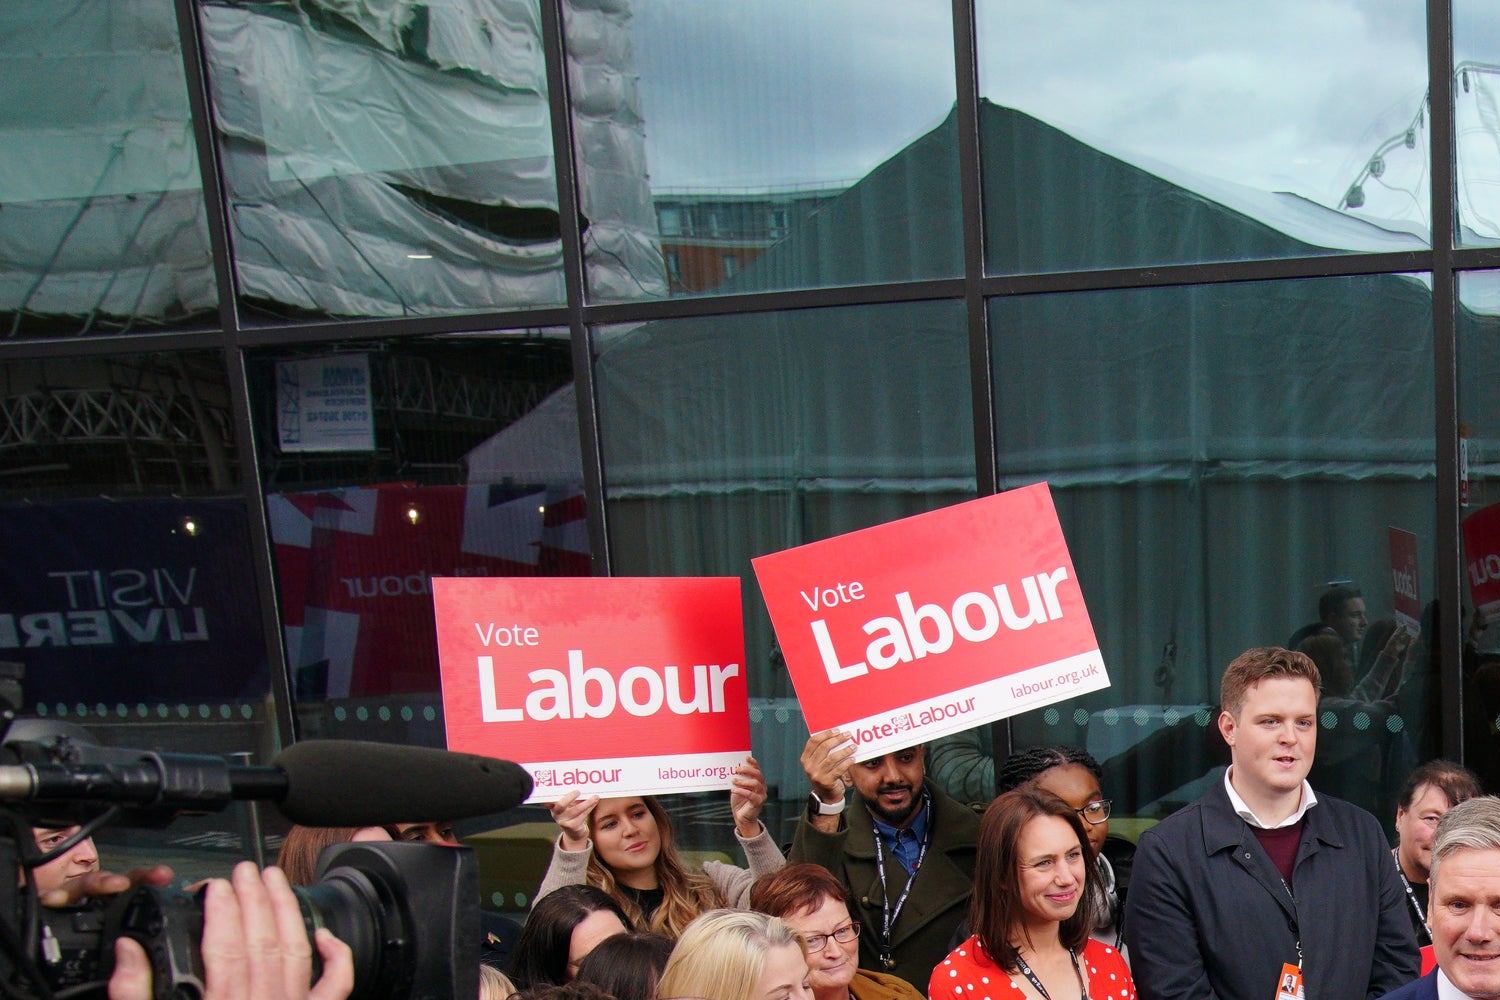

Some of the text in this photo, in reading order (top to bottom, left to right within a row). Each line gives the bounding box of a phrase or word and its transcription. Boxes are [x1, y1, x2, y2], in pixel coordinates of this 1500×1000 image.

[800, 580, 866, 612] Vote
[474, 622, 540, 647] Vote
[810, 566, 1069, 685] Labour
[477, 649, 739, 723] Labour
[850, 722, 892, 747] Vote
[908, 696, 976, 729] Labour
[1010, 663, 1100, 699] labour.org.uk
[552, 763, 743, 786] Labour labour.org.u
